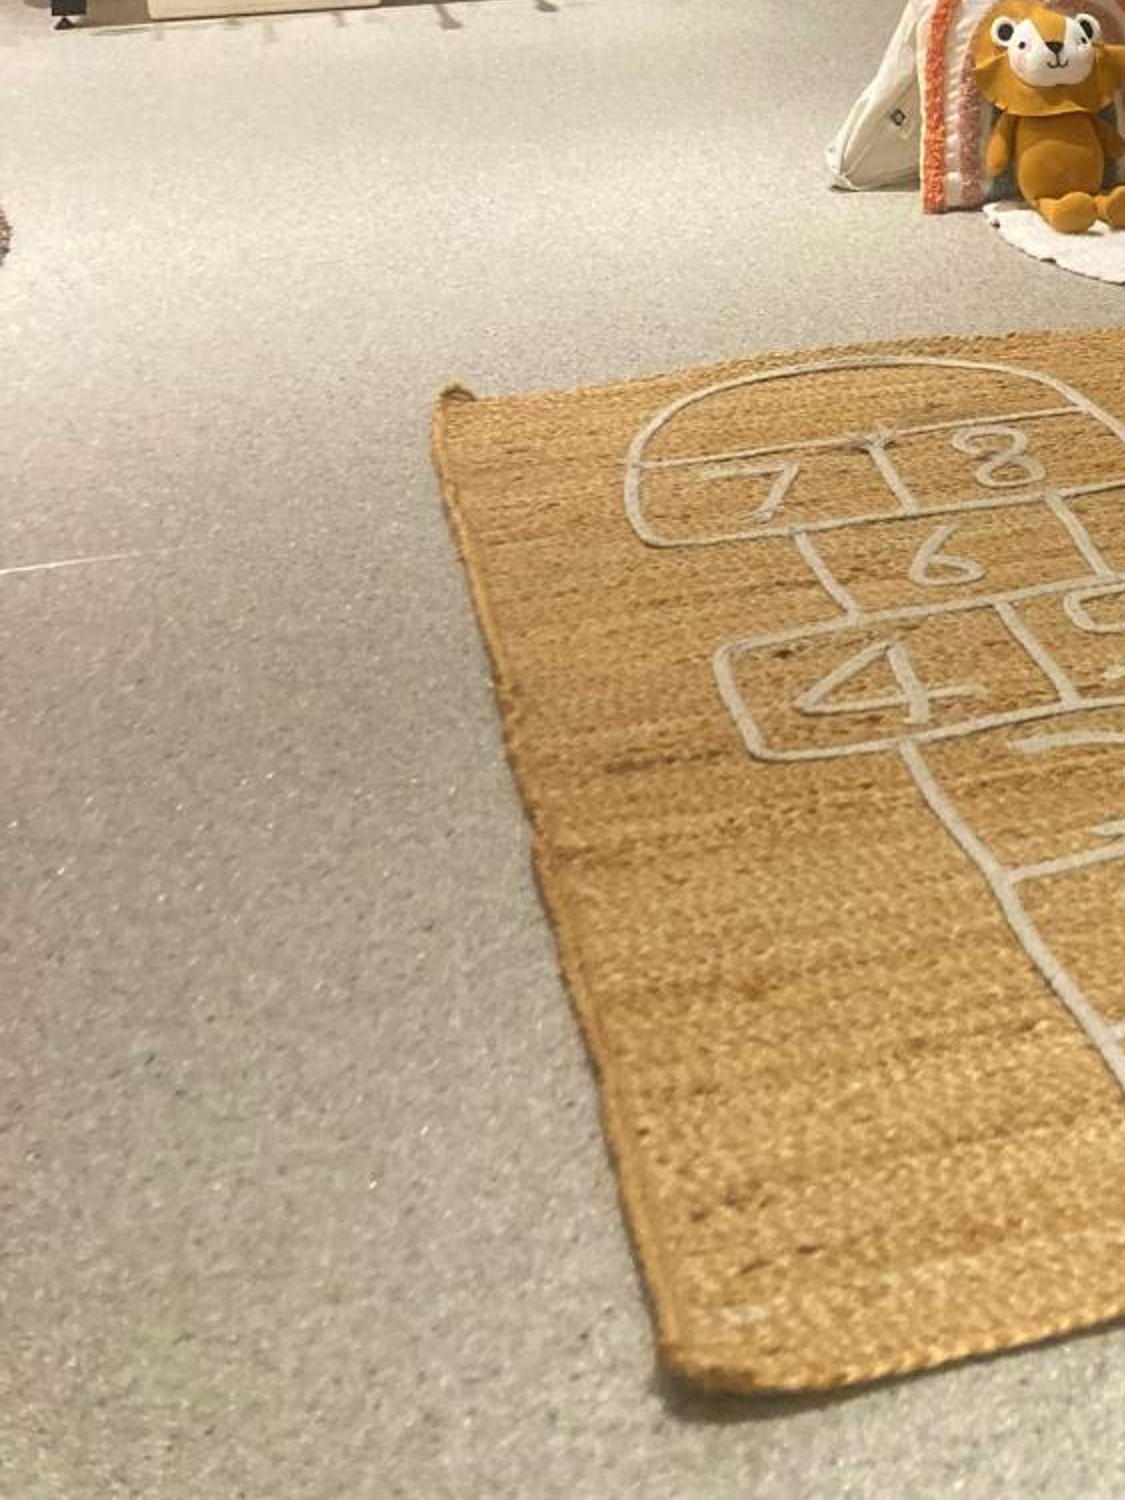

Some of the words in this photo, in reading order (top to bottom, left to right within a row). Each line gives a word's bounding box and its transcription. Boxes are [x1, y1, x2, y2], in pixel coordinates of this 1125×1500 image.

[951, 424, 1047, 489] 8
[694, 464, 800, 522] 7
[907, 525, 987, 587] 6
[794, 638, 992, 725] 4
